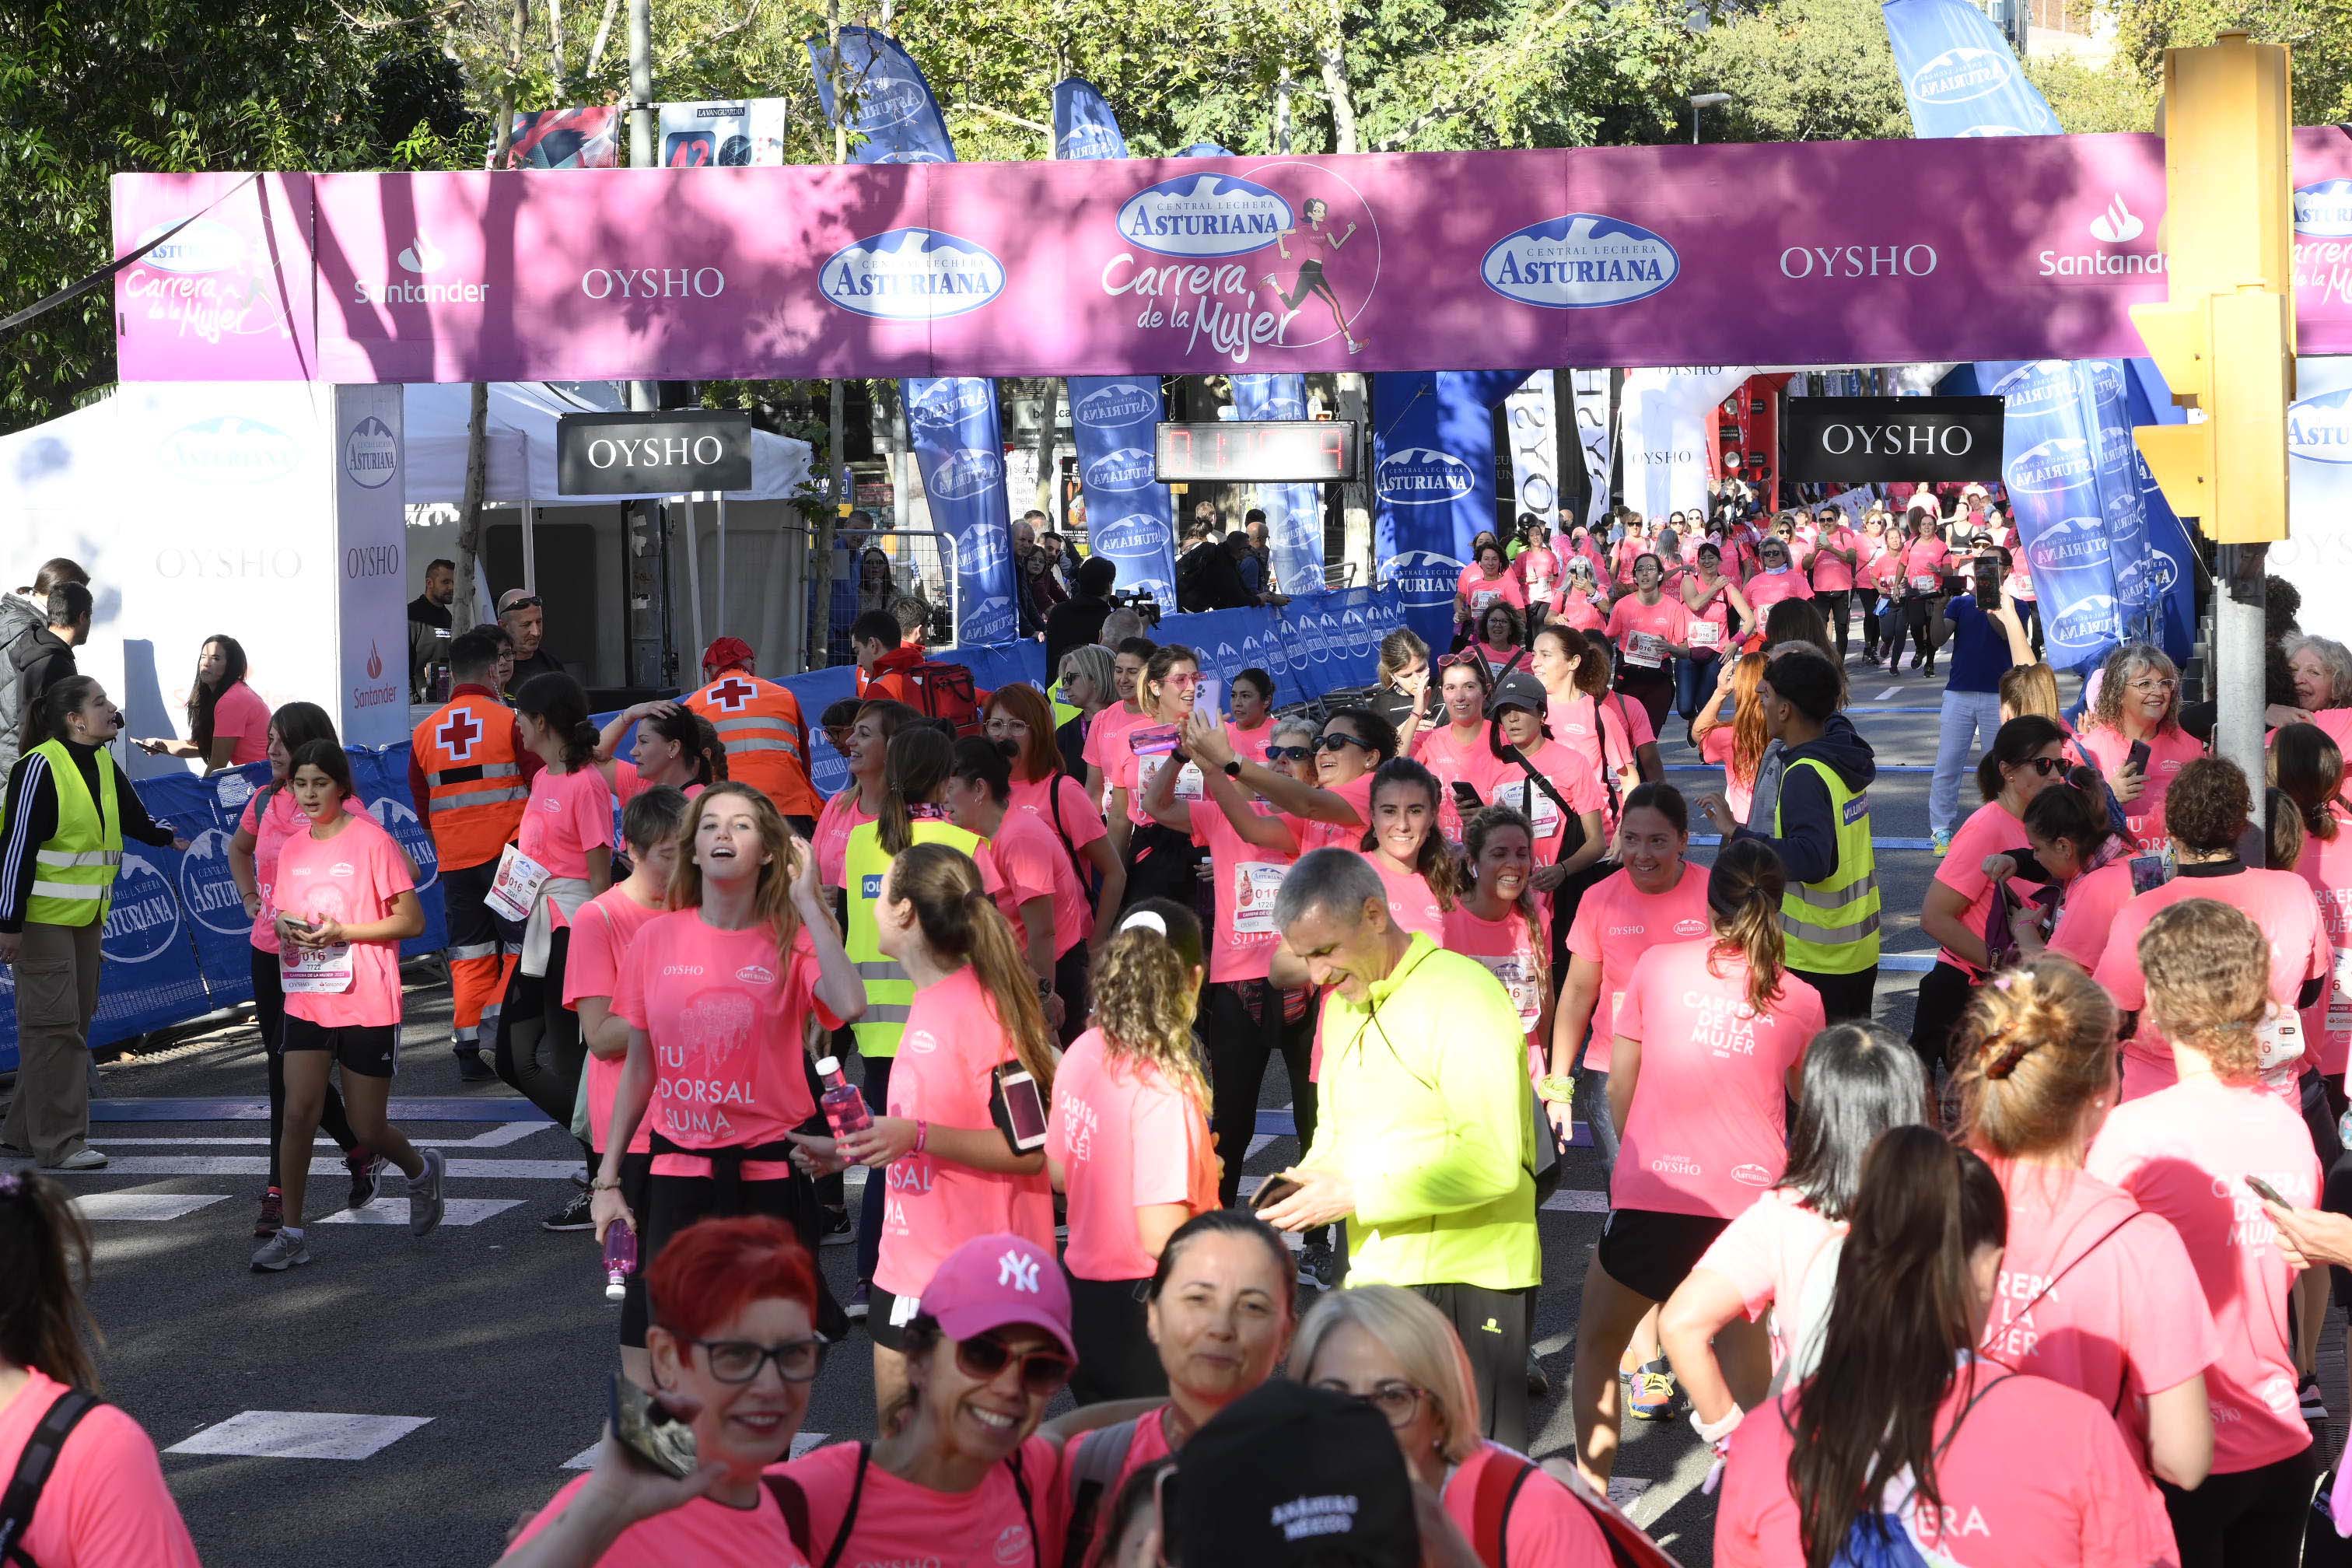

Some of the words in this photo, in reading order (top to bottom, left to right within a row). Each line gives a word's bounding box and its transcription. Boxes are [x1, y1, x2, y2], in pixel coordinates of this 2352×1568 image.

[1157, 202, 1213, 212] CENTRAL
[1217, 201, 1275, 211] LECHERA
[1130, 205, 1279, 236] ASTURIANA
[1527, 247, 1588, 257] CENTRAL
[1594, 245, 1657, 255] LECHERA
[1780, 244, 1937, 278] OYSHO
[835, 261, 992, 298] ASTURIANA
[1102, 253, 1248, 296] Carrera
[1496, 250, 1664, 285] ASTURIANA
[124, 268, 216, 299] Carrera
[355, 279, 490, 303] Santander
[581, 267, 725, 299] OYSHO
[179, 297, 251, 344] Mujer
[1137, 298, 1164, 328] de
[1171, 299, 1188, 328] la
[1185, 293, 1301, 364] Mujer
[588, 436, 723, 468] OYSHO
[1822, 424, 1972, 456] OYSHO
[349, 445, 394, 471] ASTURIANA
[1633, 450, 1691, 464] OYSHO
[1379, 471, 1467, 492] ASTURIANA
[347, 544, 398, 579] OYSHO
[354, 684, 397, 709] Santander
[509, 877, 523, 893] 016
[863, 880, 881, 893] VOL
[1609, 926, 1644, 935] OYSHO
[303, 951, 326, 961] 016
[663, 964, 704, 976] OYSHO
[1698, 1013, 1724, 1030] DE
[1731, 1020, 1755, 1038] LA
[1690, 1029, 1755, 1056] MUJER
[660, 1045, 684, 1068] TU
[660, 1077, 755, 1104] DORSAL
[666, 1108, 731, 1133] SUMA
[1653, 1160, 1701, 1176] OYSHO
[998, 1249, 1041, 1294] NY
[1919, 1506, 1991, 1537] ERA
